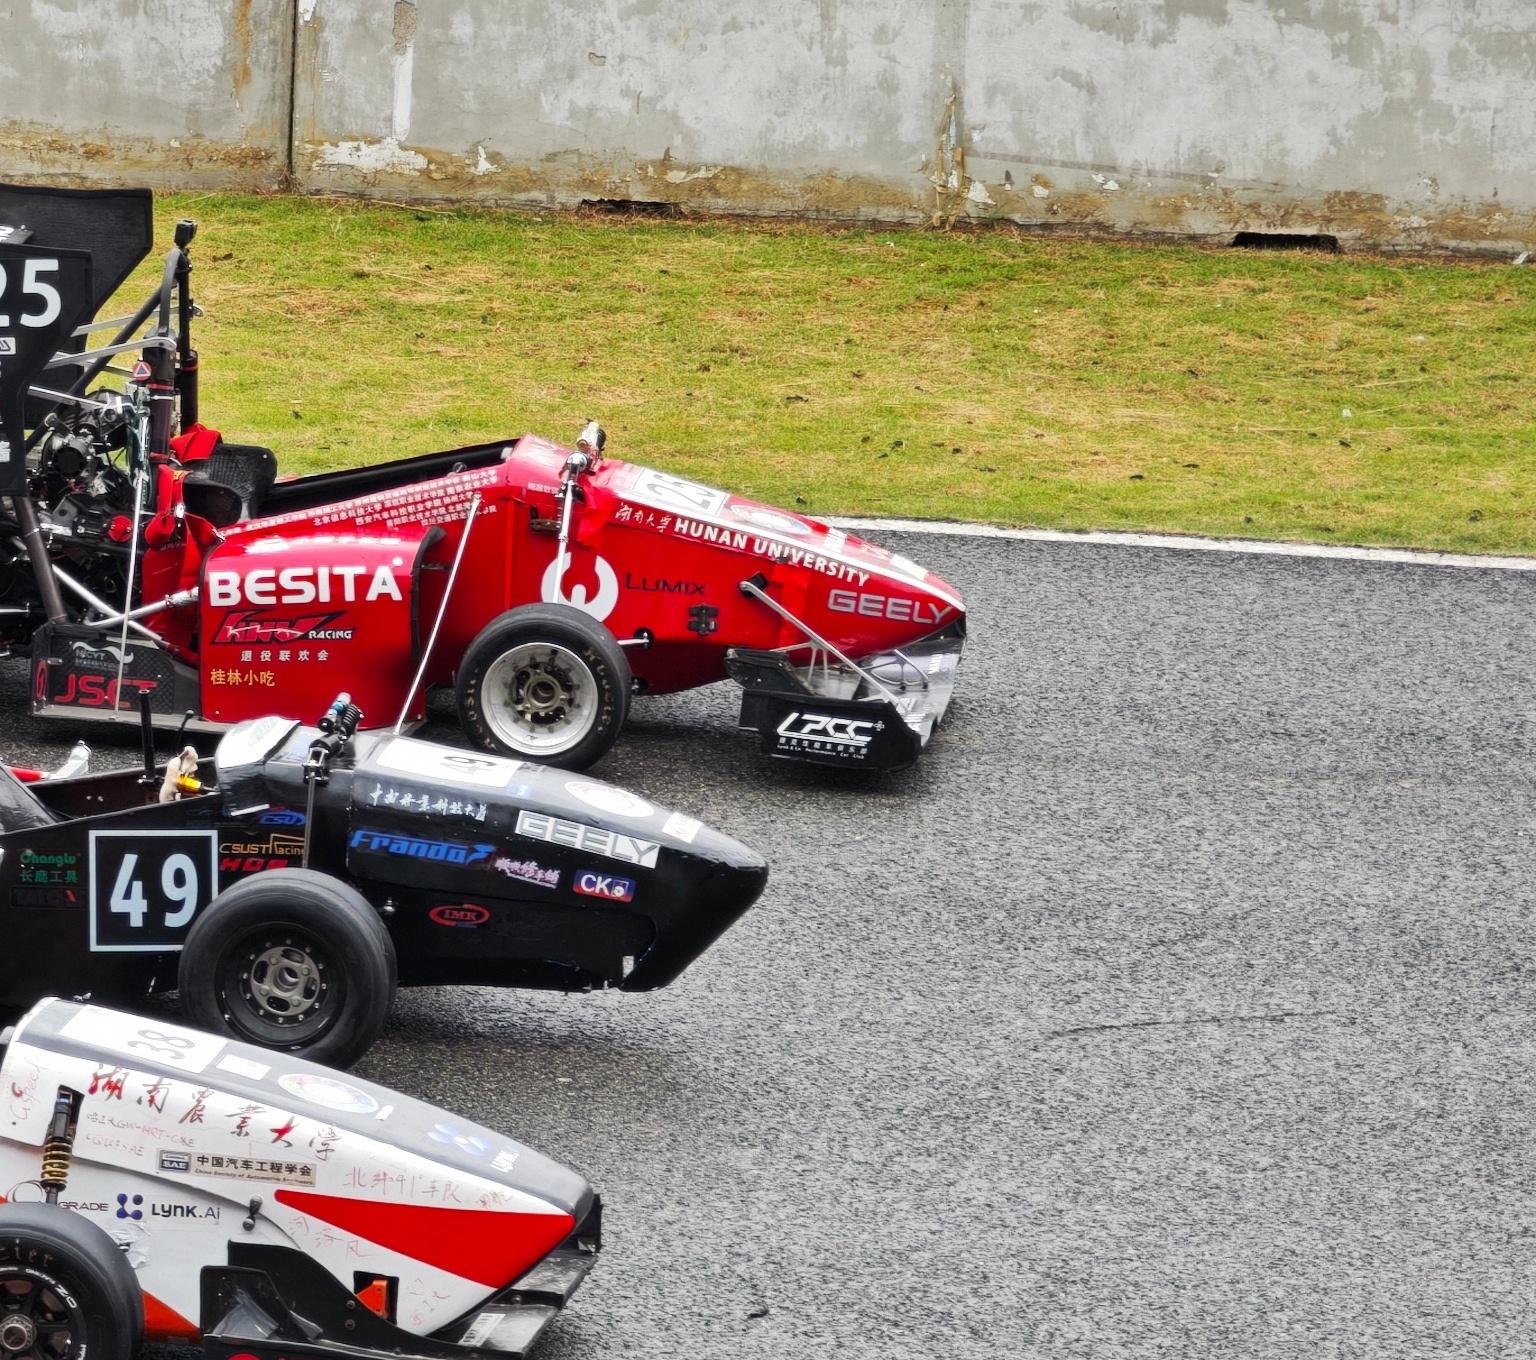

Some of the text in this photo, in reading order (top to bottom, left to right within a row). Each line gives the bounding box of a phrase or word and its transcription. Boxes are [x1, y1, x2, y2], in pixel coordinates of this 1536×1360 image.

[674, 517, 870, 588] HUNAN UNIVERSITY
[209, 565, 403, 607] BESITA
[625, 571, 707, 597] LUMIX
[827, 589, 953, 625] GEELY
[308, 630, 353, 640] RACING
[210, 668, 276, 687] 桂林小吃
[517, 811, 660, 866] GEELY
[110, 852, 199, 928] 49
[443, 907, 480, 921] IMK
[161, 1160, 188, 1170] SAE
[196, 1154, 314, 1178] 中国汽车工程学会
